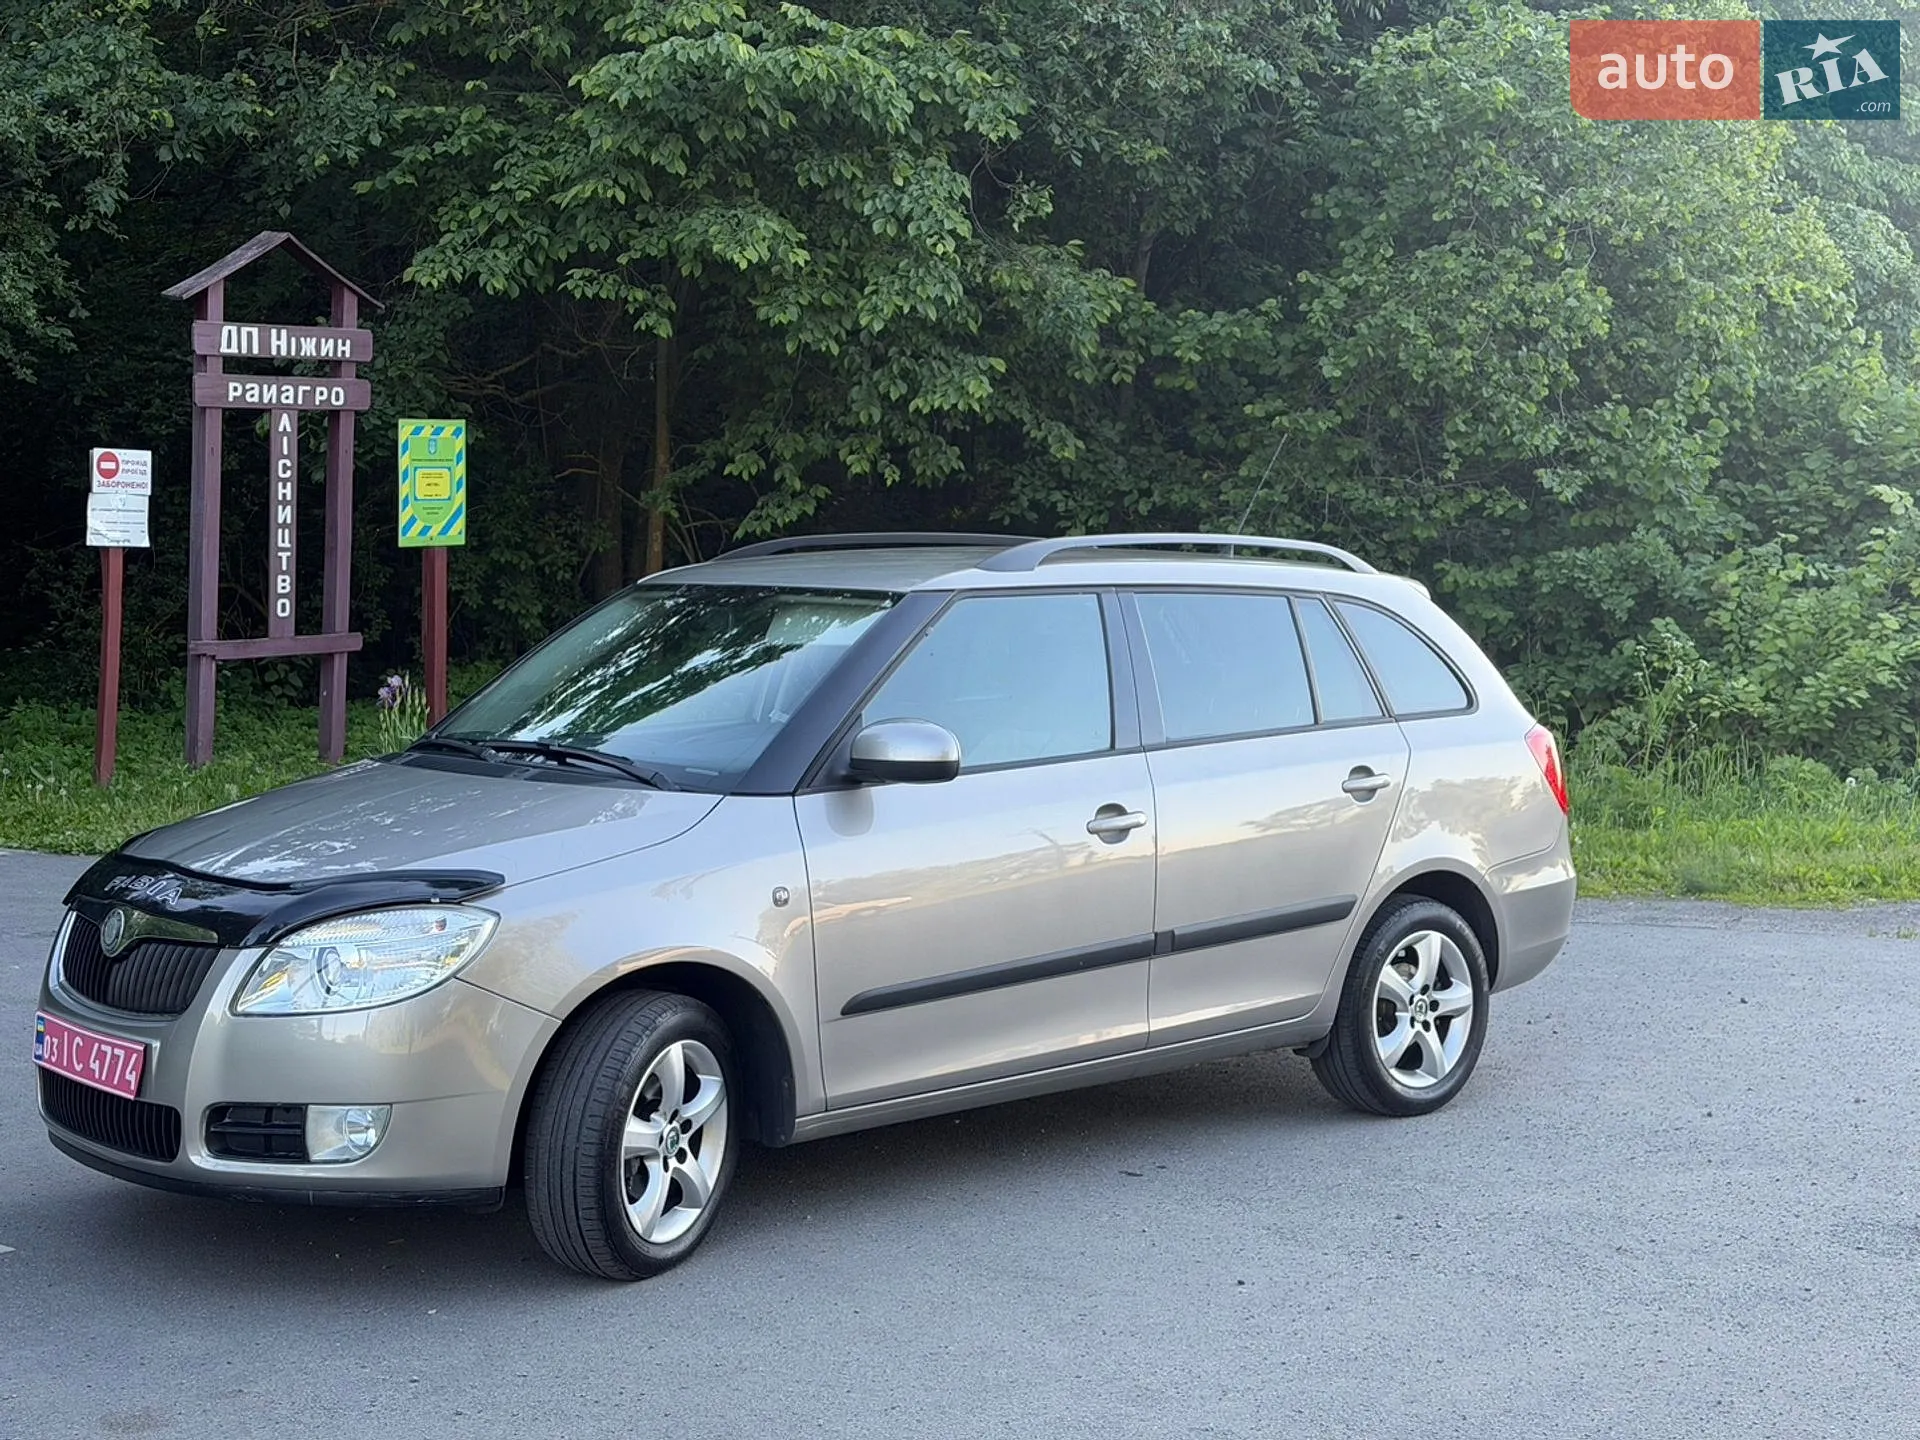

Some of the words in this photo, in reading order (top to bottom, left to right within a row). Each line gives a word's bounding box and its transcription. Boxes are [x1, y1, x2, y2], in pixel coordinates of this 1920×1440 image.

[220, 325, 259, 354] ДП
[43, 1035, 59, 1063] 03
[63, 1031, 84, 1072] IC
[89, 1042, 138, 1091] 4774
